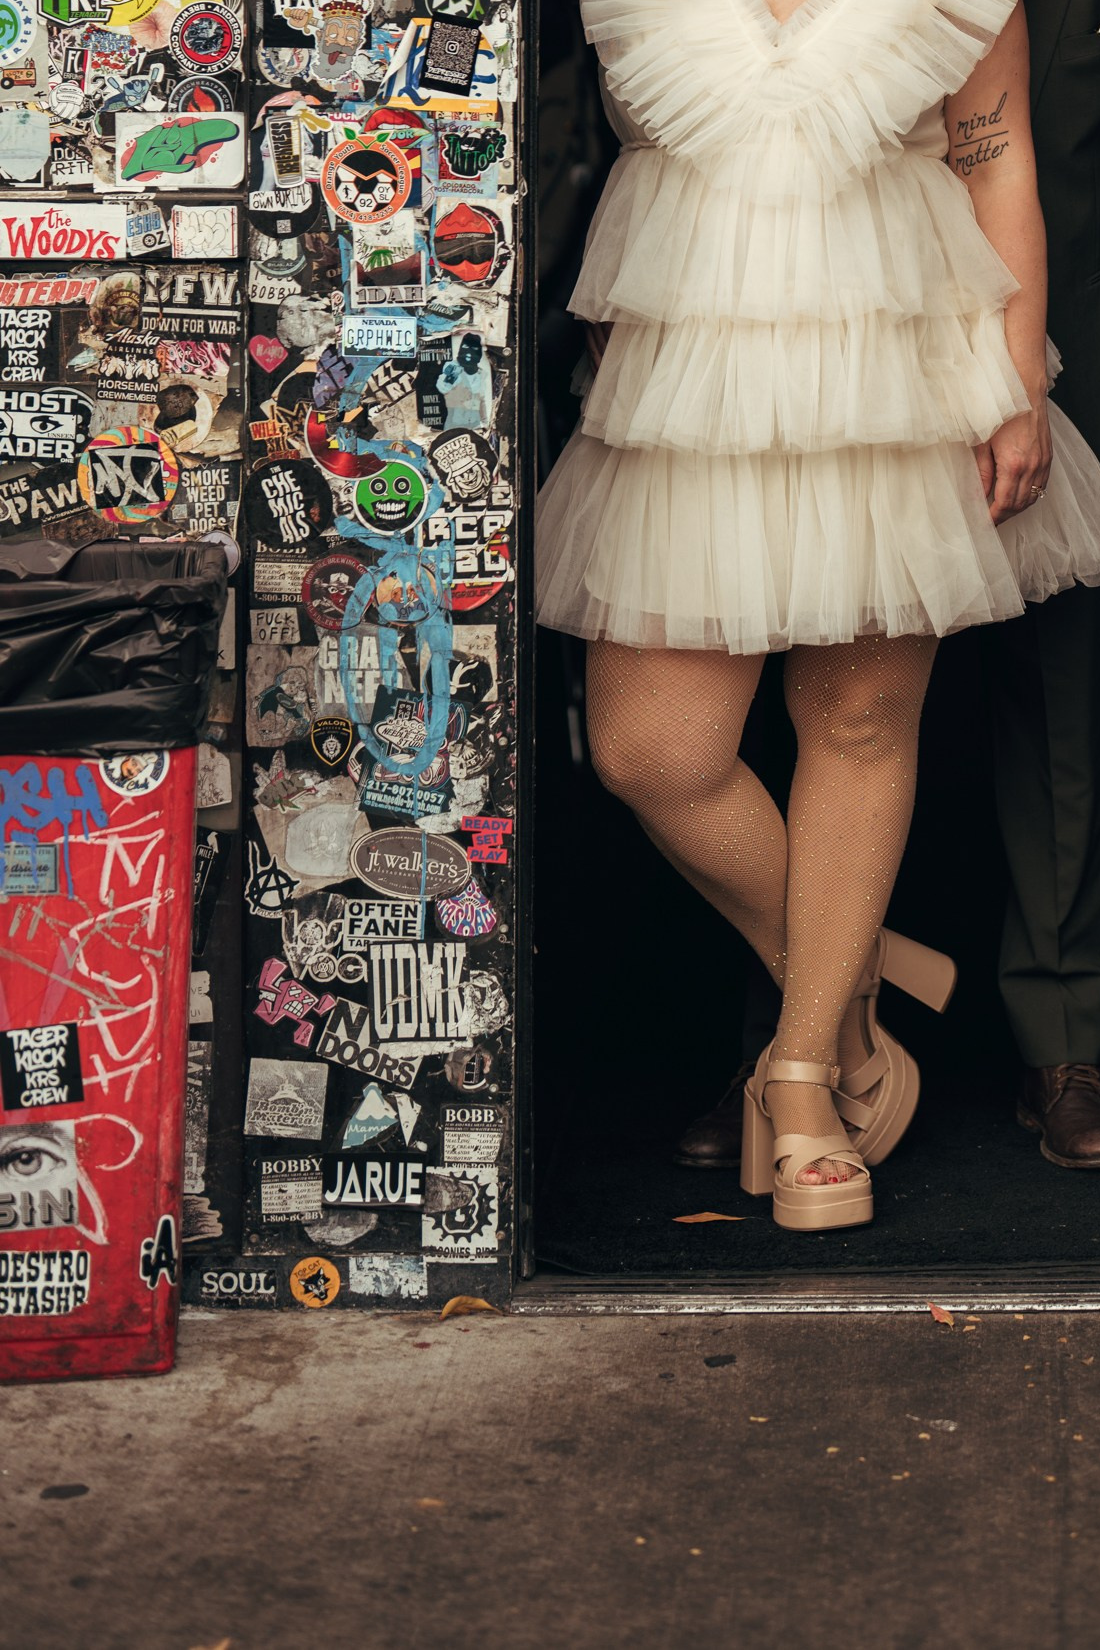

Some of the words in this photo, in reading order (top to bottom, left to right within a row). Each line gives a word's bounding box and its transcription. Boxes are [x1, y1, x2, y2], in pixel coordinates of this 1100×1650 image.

[957, 91, 1008, 140] mind
[955, 140, 1009, 176] matter
[326, 160, 335, 191] Orange
[335, 143, 355, 161] Youth
[379, 144, 400, 165] Soccer
[398, 165, 406, 195] League
[377, 185, 391, 194] OY
[379, 193, 390, 201] SL
[359, 197, 374, 208] 92
[46, 207, 71, 229] the
[3, 218, 121, 259] WOODYS
[142, 317, 181, 334] DOWN
[183, 318, 208, 334] FOR
[211, 318, 236, 334] WAR
[361, 318, 398, 327] NEVADA
[107, 329, 162, 346] Alaska
[8, 350, 39, 367] KRS
[107, 345, 155, 355] AIRLINES
[2, 366, 46, 382] CREW
[98, 380, 158, 392] HORSEMEN
[97, 391, 157, 402] CREWMEMBER
[182, 468, 229, 486] SMOKE
[261, 469, 300, 497] CHE
[188, 486, 224, 502] WEED
[195, 502, 220, 517] PET
[269, 492, 306, 518] MIC
[190, 517, 226, 532] DOGS
[280, 512, 311, 545] ALS
[257, 611, 293, 627] FUCK
[317, 719, 346, 728] VALOR
[465, 819, 510, 832] READY
[475, 833, 499, 846] SET
[469, 848, 504, 861] PLAY
[386, 849, 459, 878] walker's
[349, 901, 418, 918] OFTEN
[349, 918, 417, 937] FANE
[8, 1026, 68, 1048] TAGER
[323, 1034, 415, 1087] DOORS
[25, 1069, 60, 1088] KRS
[20, 1085, 68, 1107] CREW
[261, 1159, 323, 1174] BOBBY
[325, 1161, 423, 1204] JARUE
[203, 1271, 275, 1294] SOUL
